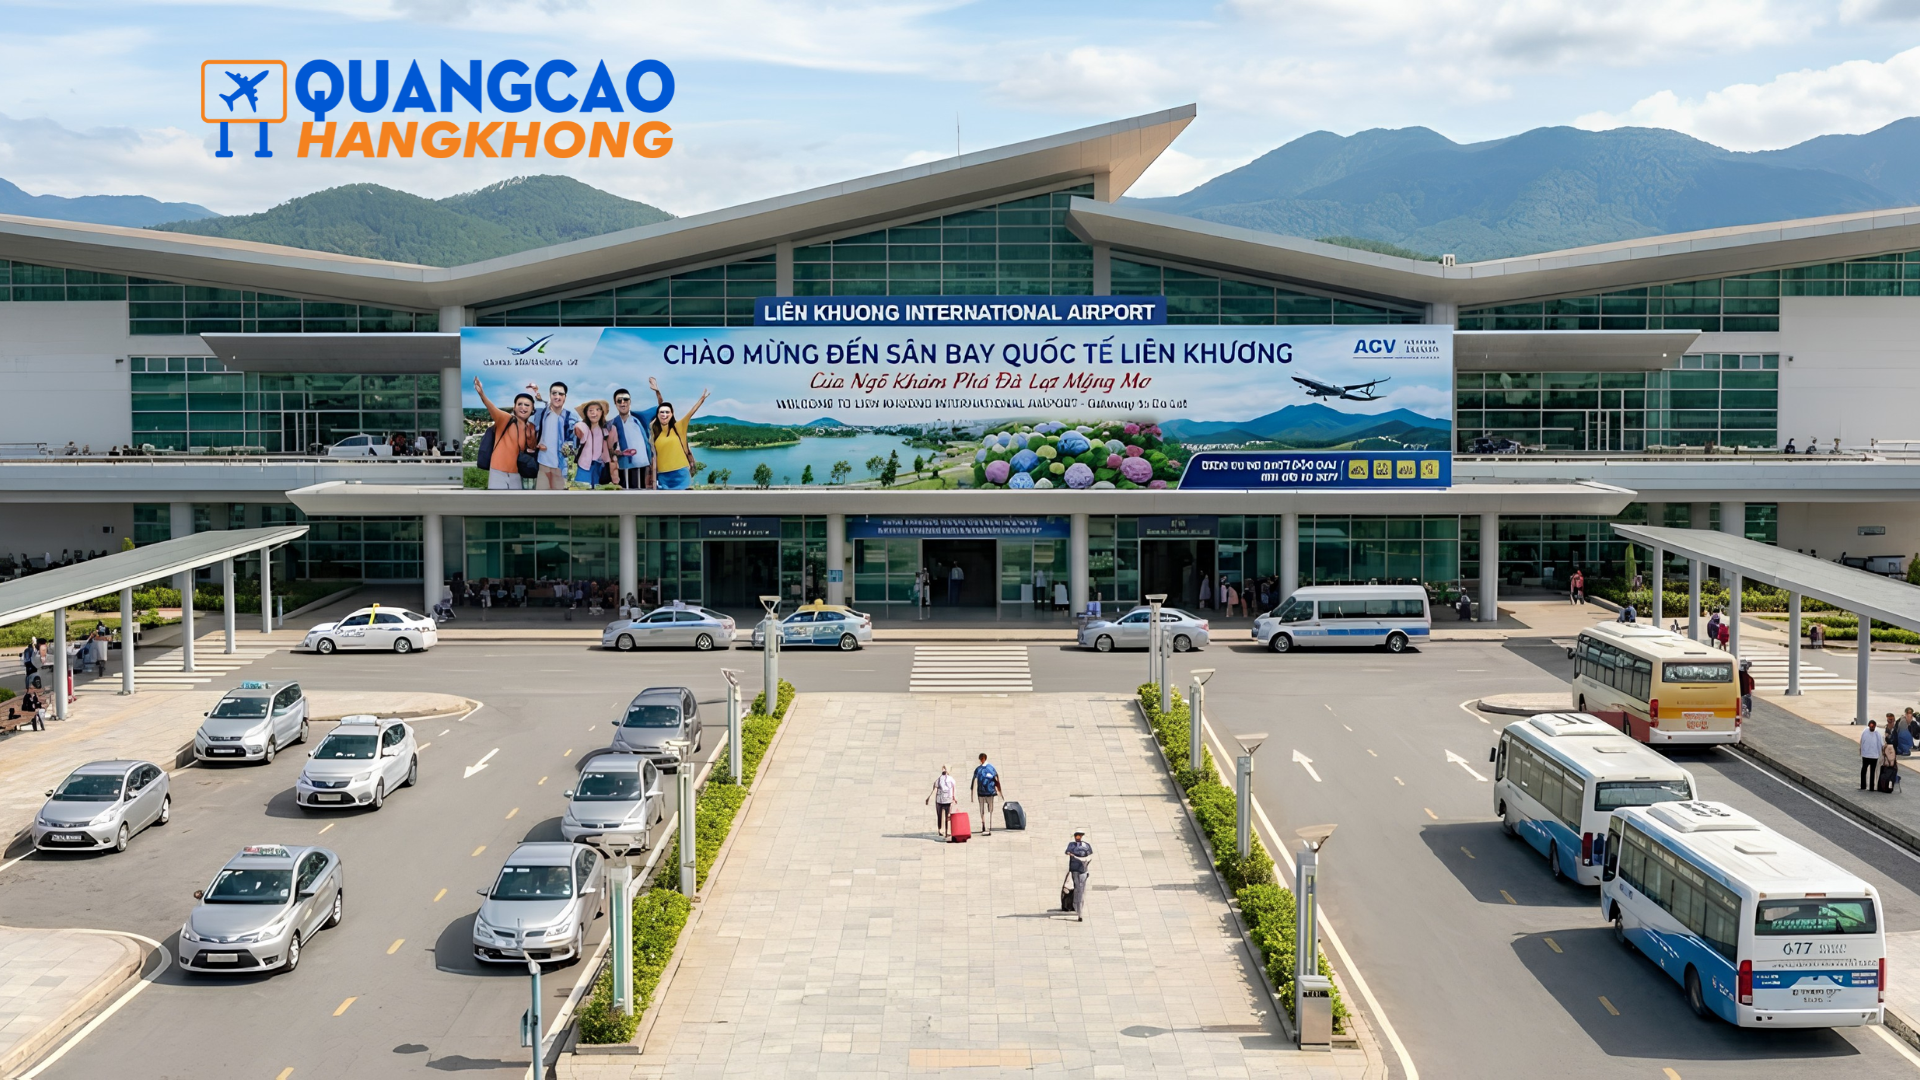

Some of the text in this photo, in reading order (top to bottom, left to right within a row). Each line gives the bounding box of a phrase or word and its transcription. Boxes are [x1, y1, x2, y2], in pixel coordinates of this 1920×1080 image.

[764, 301, 1156, 321] LIÊN KHUONG INTERNATIONAL AIRPORT
[663, 335, 1293, 367] CHÀO MỪNG ĐẾN SÂN BAY QUỐC TẾ LIÊN KHƯƠNG
[1353, 338, 1397, 354] ACV
